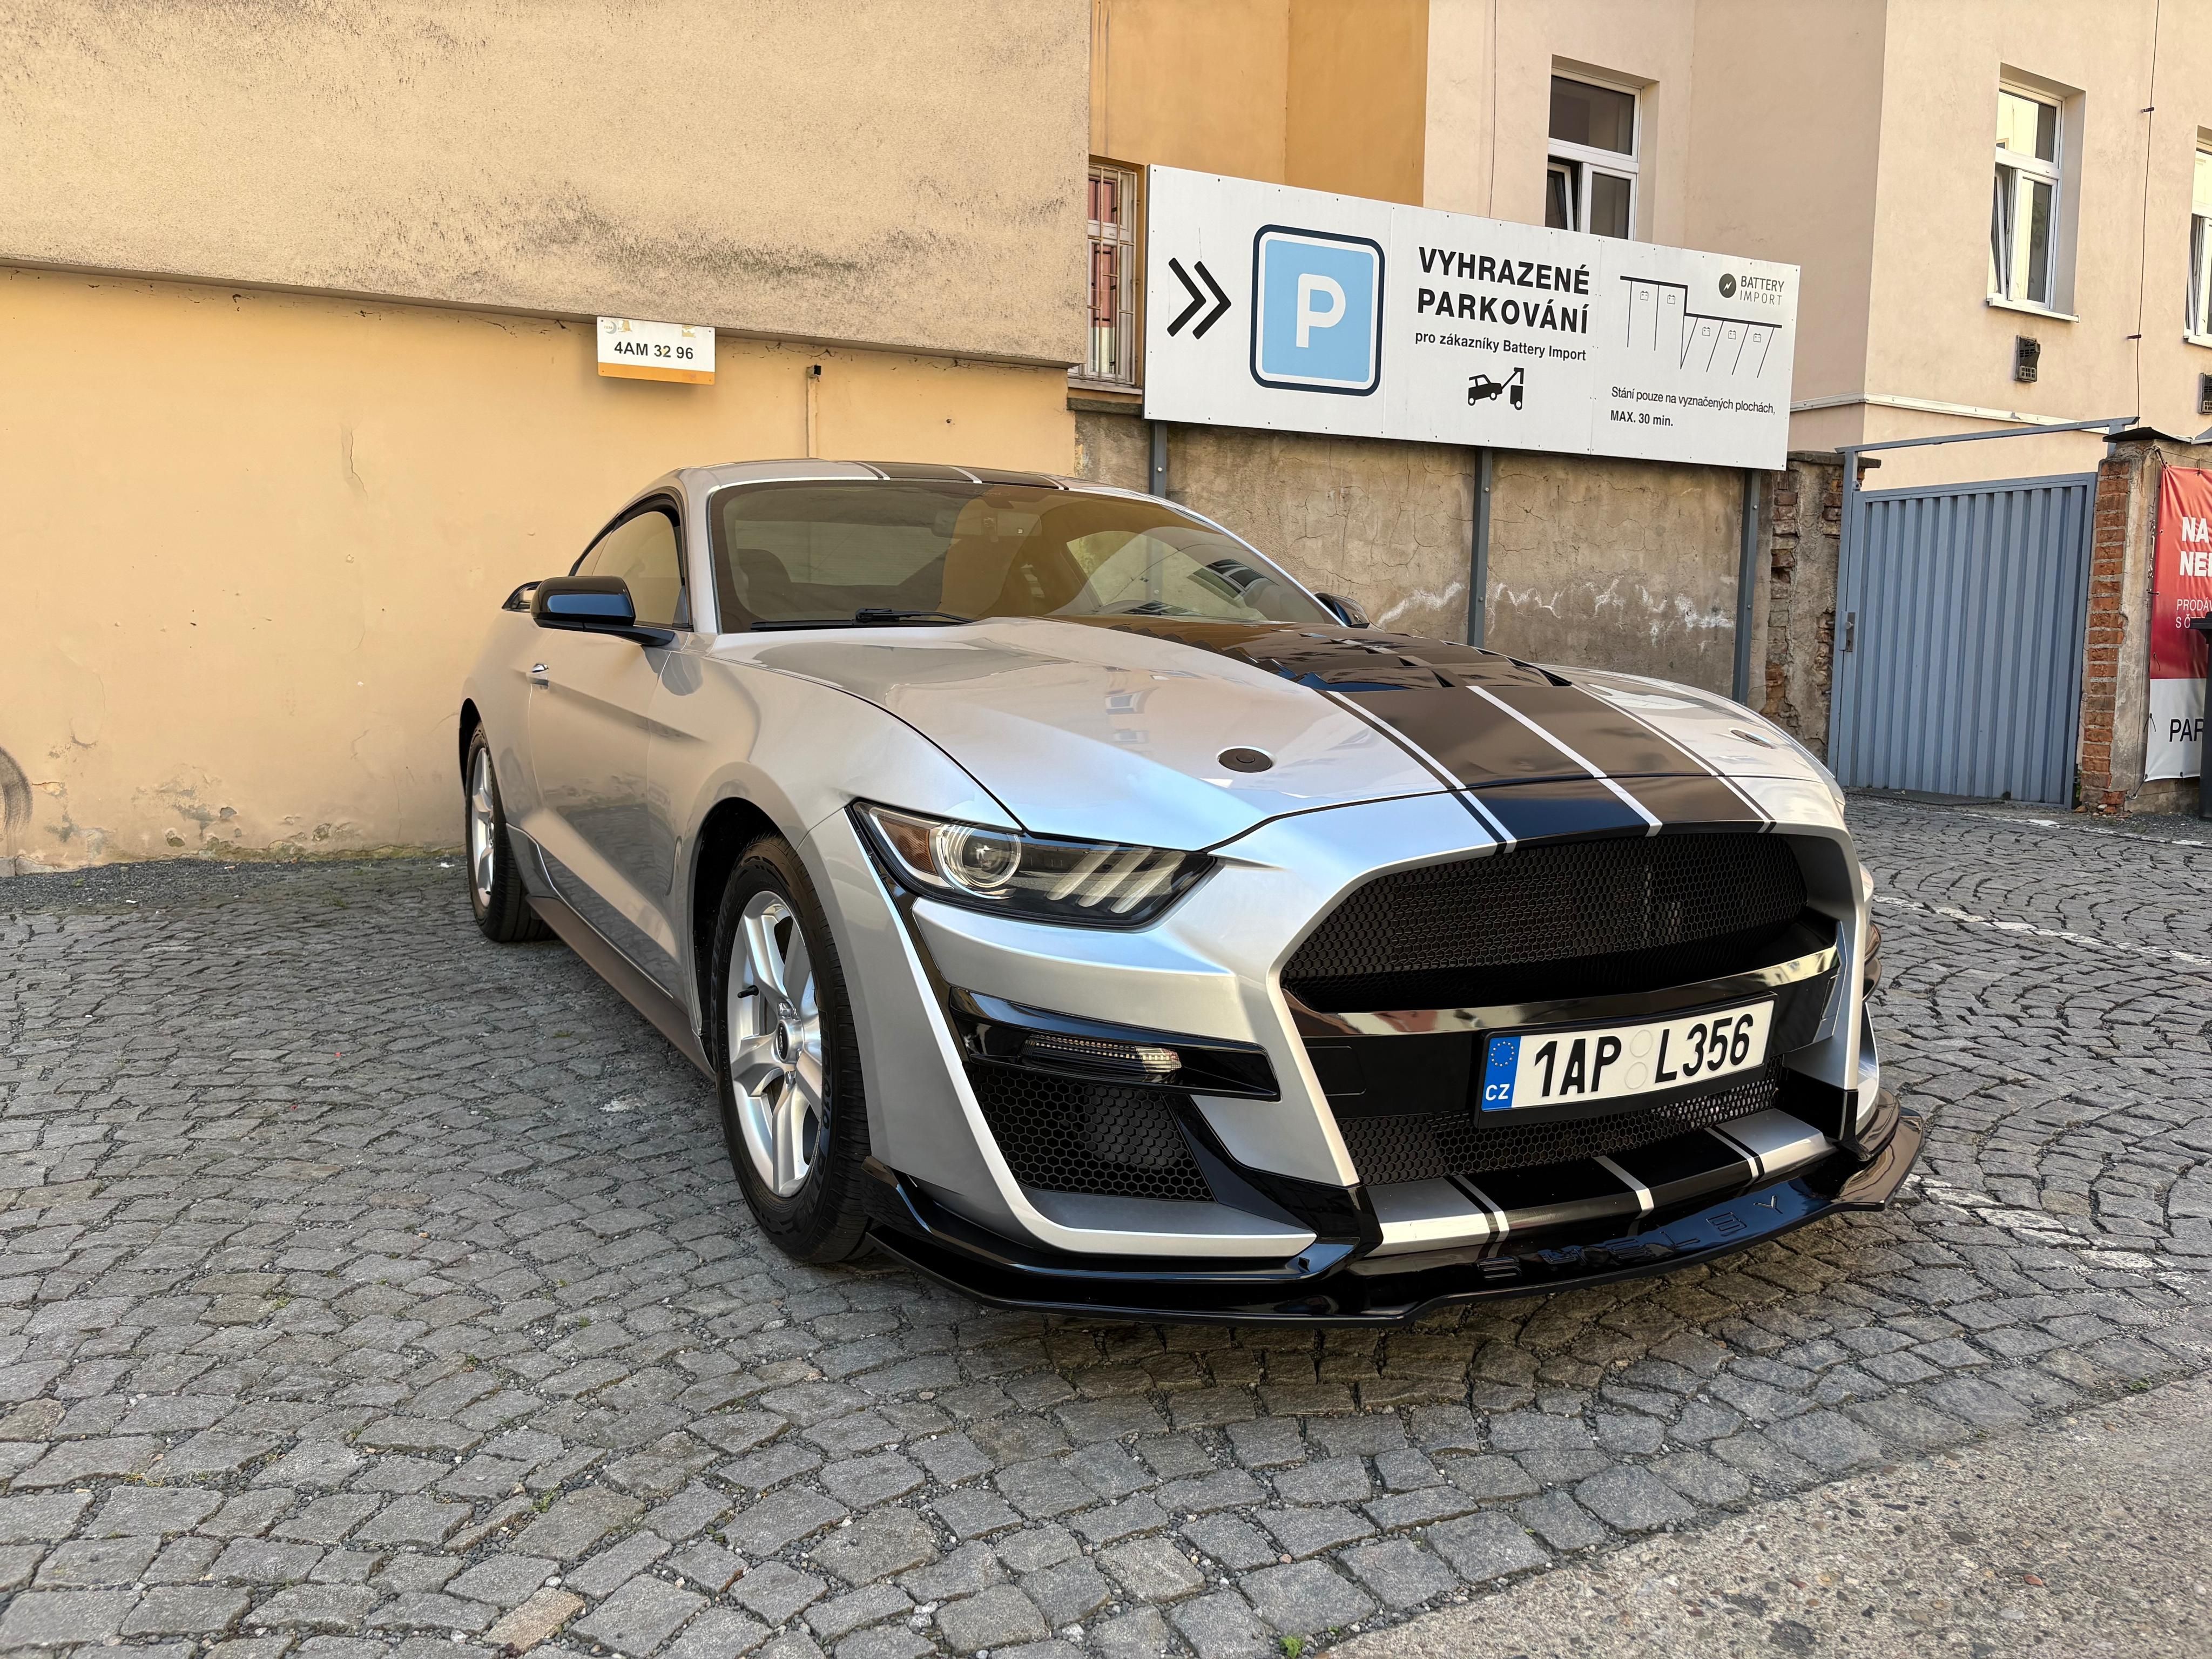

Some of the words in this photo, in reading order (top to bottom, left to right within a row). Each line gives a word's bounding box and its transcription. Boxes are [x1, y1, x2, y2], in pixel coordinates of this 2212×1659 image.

[1419, 246, 1589, 295] VYHRAZENÉ
[1741, 275, 1784, 292] BATTERY
[1296, 273, 1346, 348] P
[1418, 288, 1589, 334] PARKOVÁNÍ
[1740, 290, 1782, 305] IMPORT
[614, 341, 648, 356] 4AM
[654, 344, 671, 358] 32
[676, 346, 693, 359] 96
[1415, 332, 1435, 344] pro
[1439, 333, 1499, 353] zákazníky
[1503, 340, 1545, 359] Battery
[1549, 346, 1586, 361] Import
[1611, 386, 1635, 399] Stání
[1636, 392, 1663, 402] pouze
[1665, 395, 1676, 404] na
[1678, 396, 1733, 411] vyznačených
[1735, 401, 1775, 415] plochách,
[1610, 410, 1636, 423] MAX.
[1638, 413, 1650, 424] 30
[1653, 415, 1674, 427] min.
[2181, 516, 2209, 543] NA
[1534, 1035, 1621, 1097] 1AP
[1654, 1013, 1754, 1084] L356
[1485, 1083, 1508, 1101] CZ
